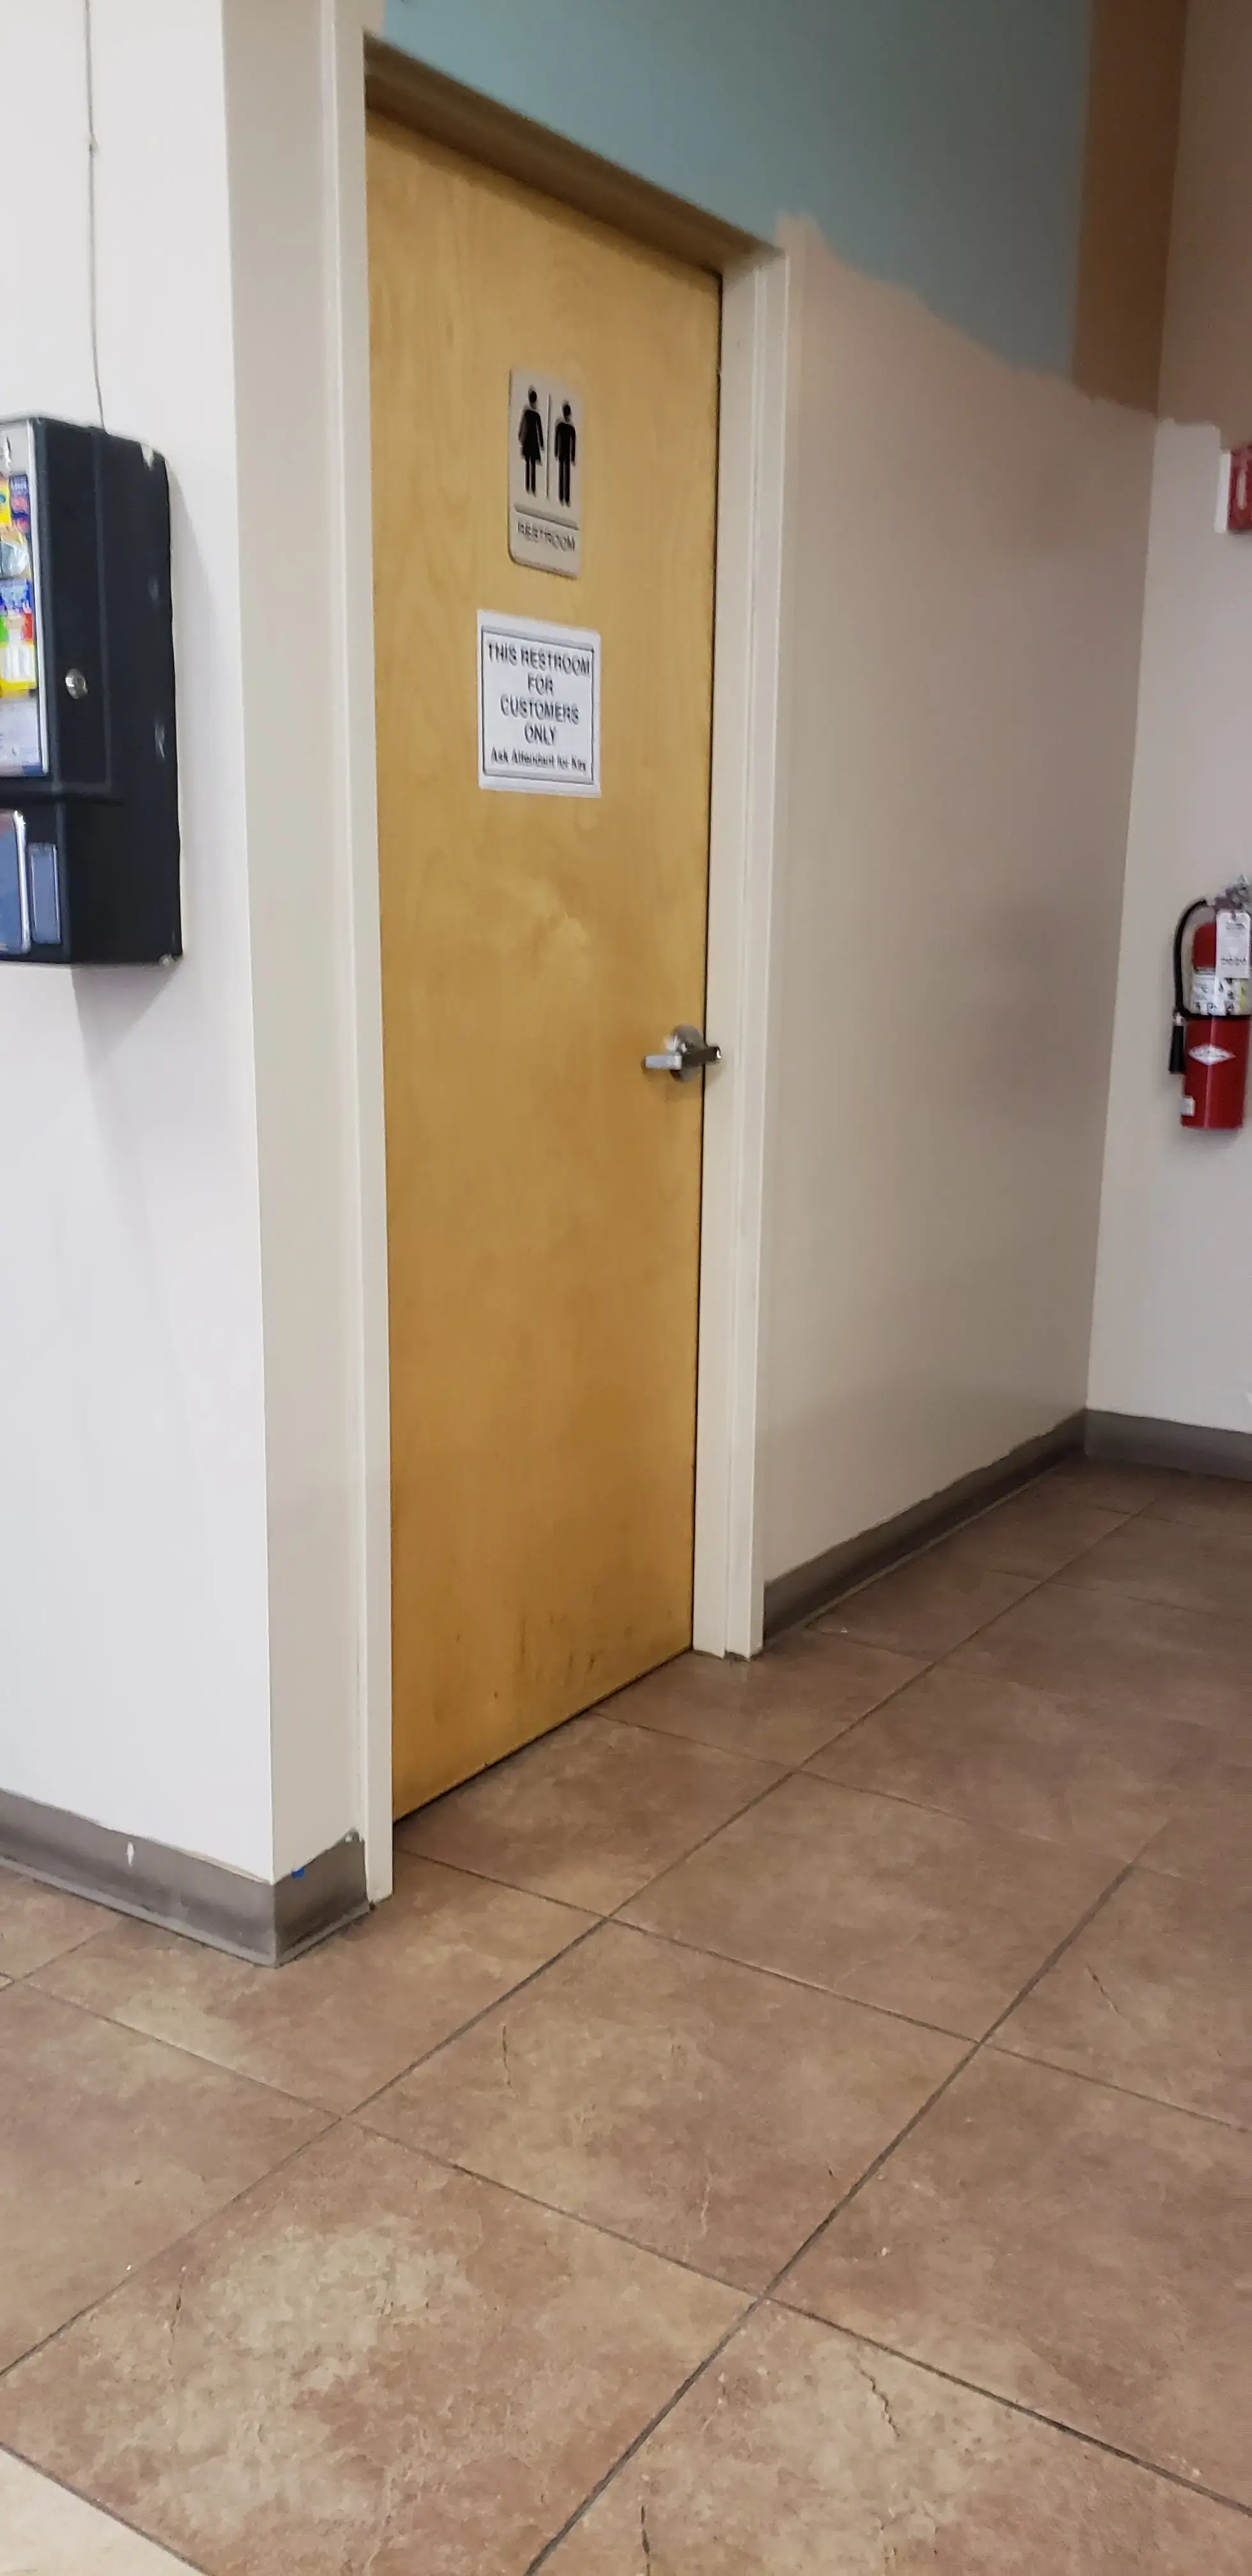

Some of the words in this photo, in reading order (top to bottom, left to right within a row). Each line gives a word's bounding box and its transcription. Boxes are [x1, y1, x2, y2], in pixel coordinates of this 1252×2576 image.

[516, 521, 576, 551] RESTROOM
[489, 641, 517, 666] THIS
[521, 645, 590, 677] RESTROOM
[528, 671, 554, 696] FOR
[501, 693, 579, 724] CUSTOMERS
[524, 721, 556, 746] ONLY
[491, 745, 509, 763] Ask
